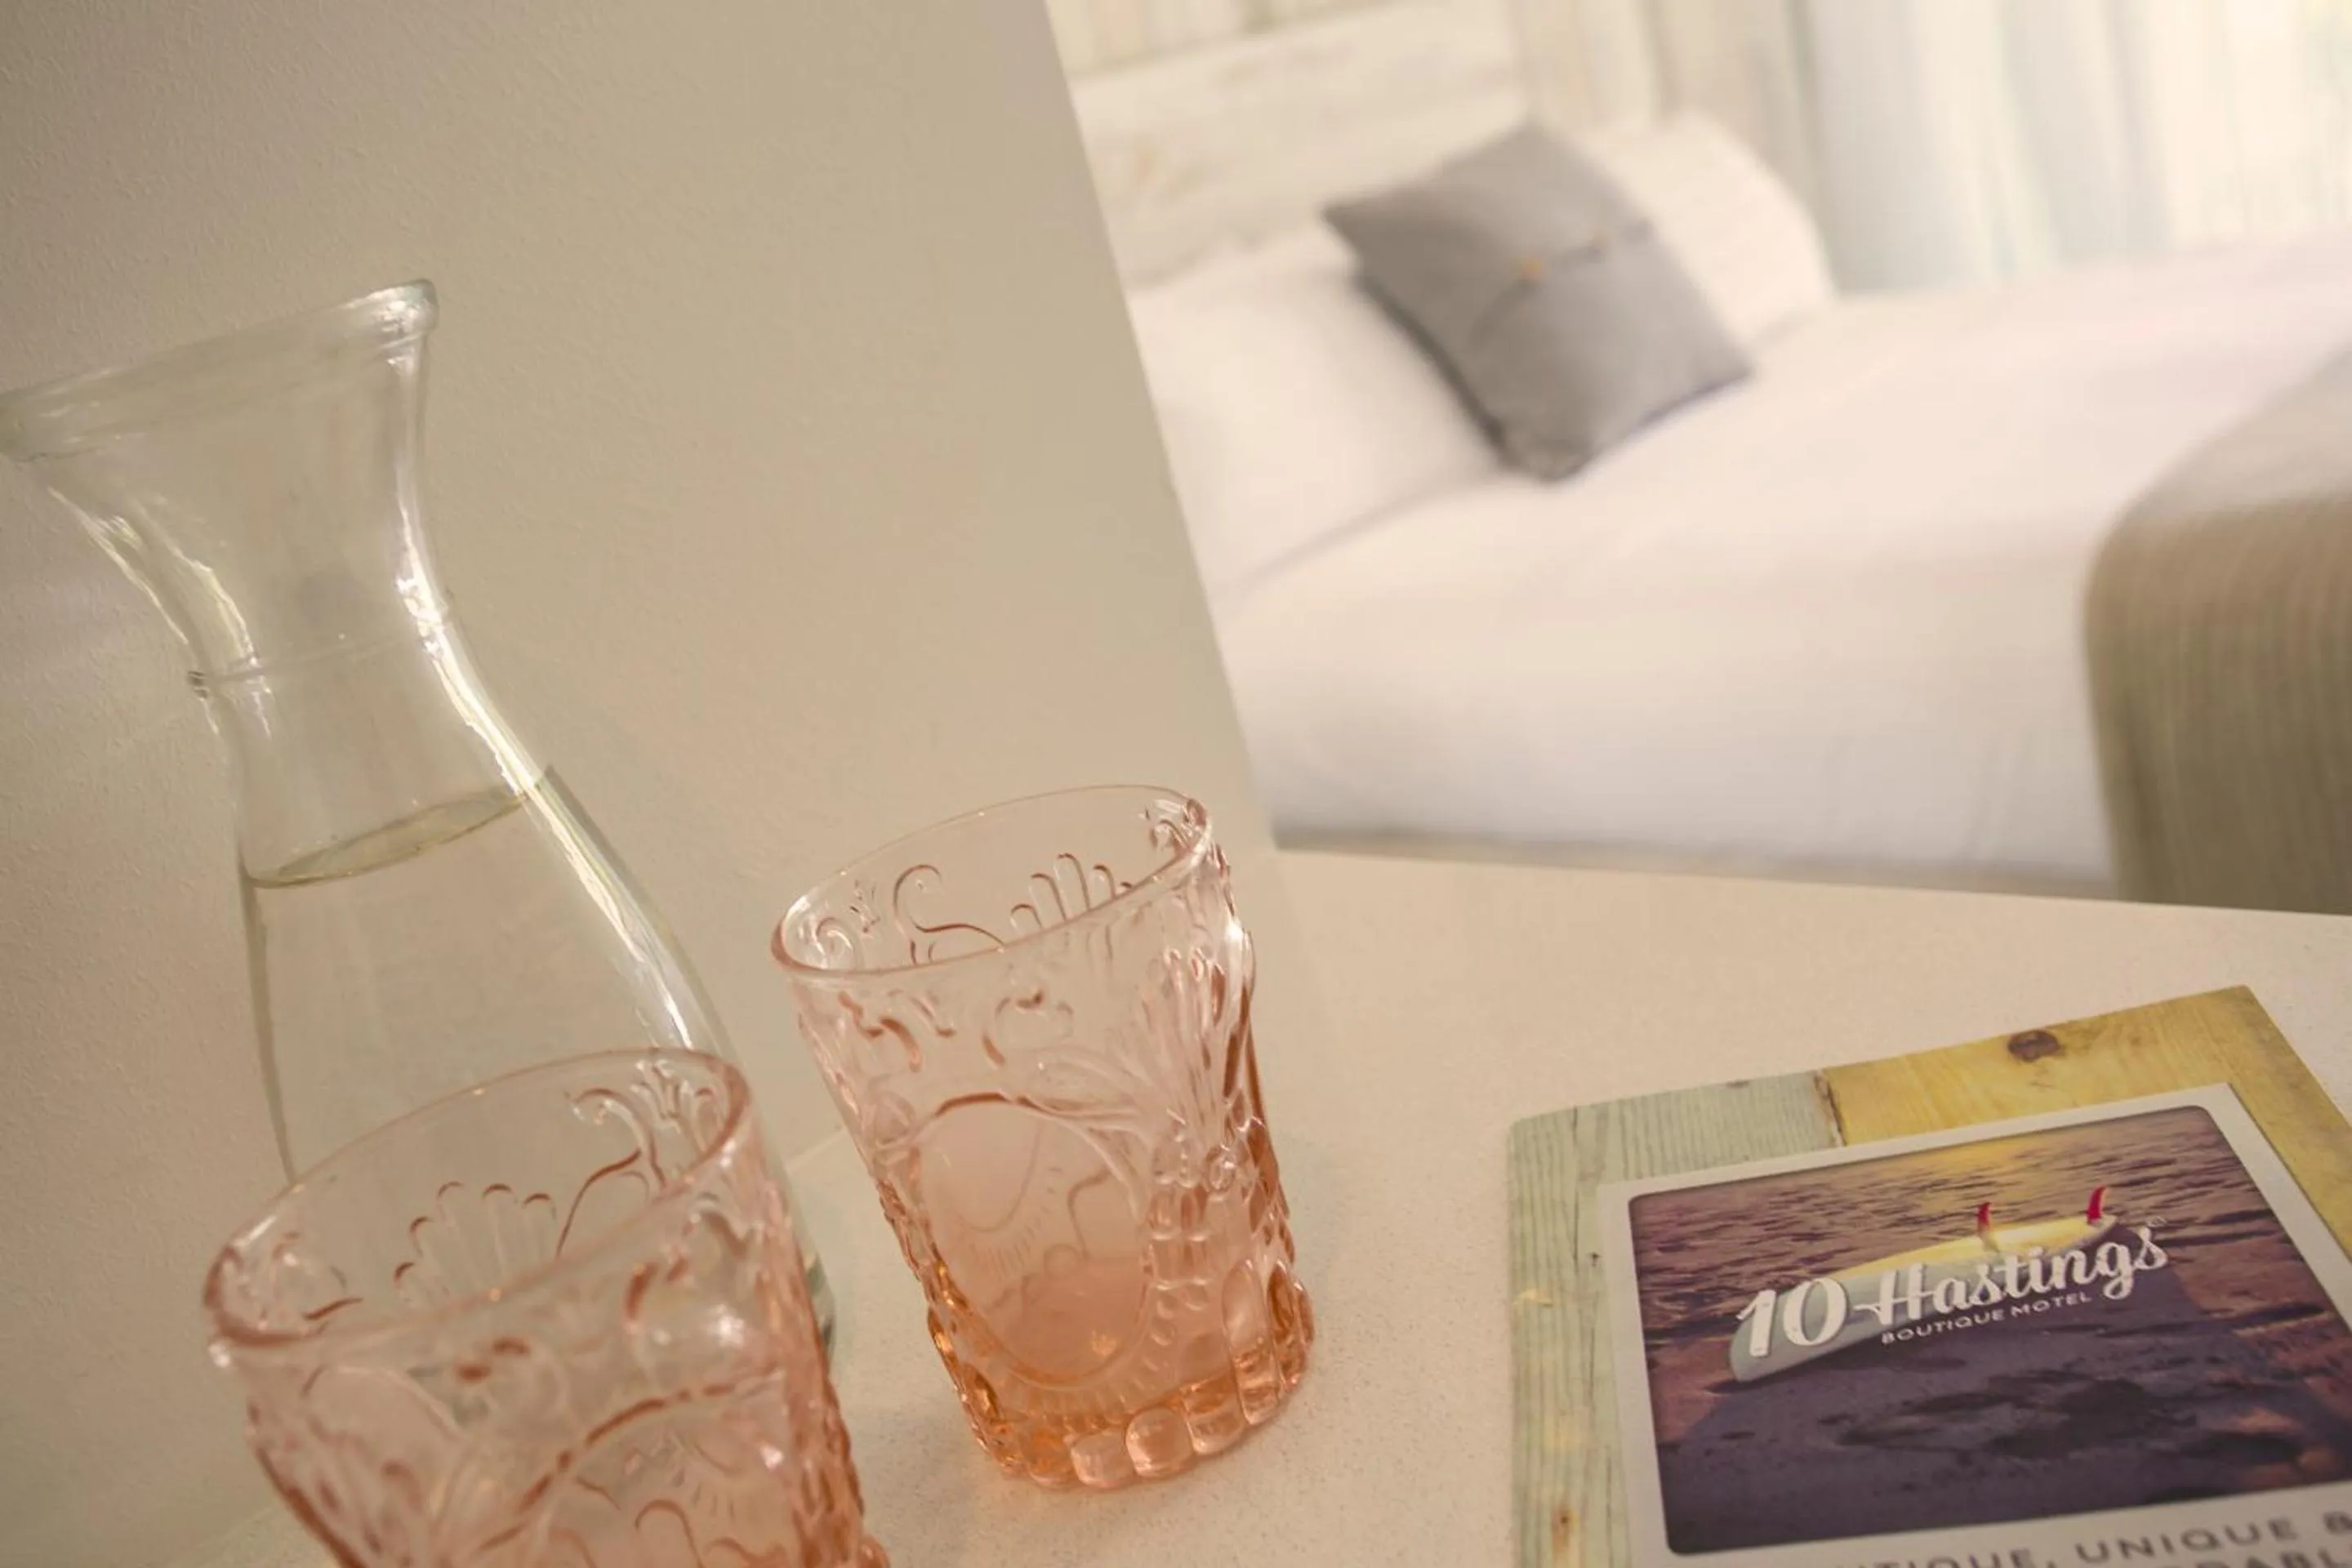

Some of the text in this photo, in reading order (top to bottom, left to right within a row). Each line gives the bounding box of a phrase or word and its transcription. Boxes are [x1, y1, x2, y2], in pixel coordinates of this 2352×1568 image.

[1735, 1226, 2168, 1357] 10 Hastings
[1881, 1292, 2092, 1344] BOUTIQUE MOTEL
[2074, 1517, 2298, 1564] UNIQUE
